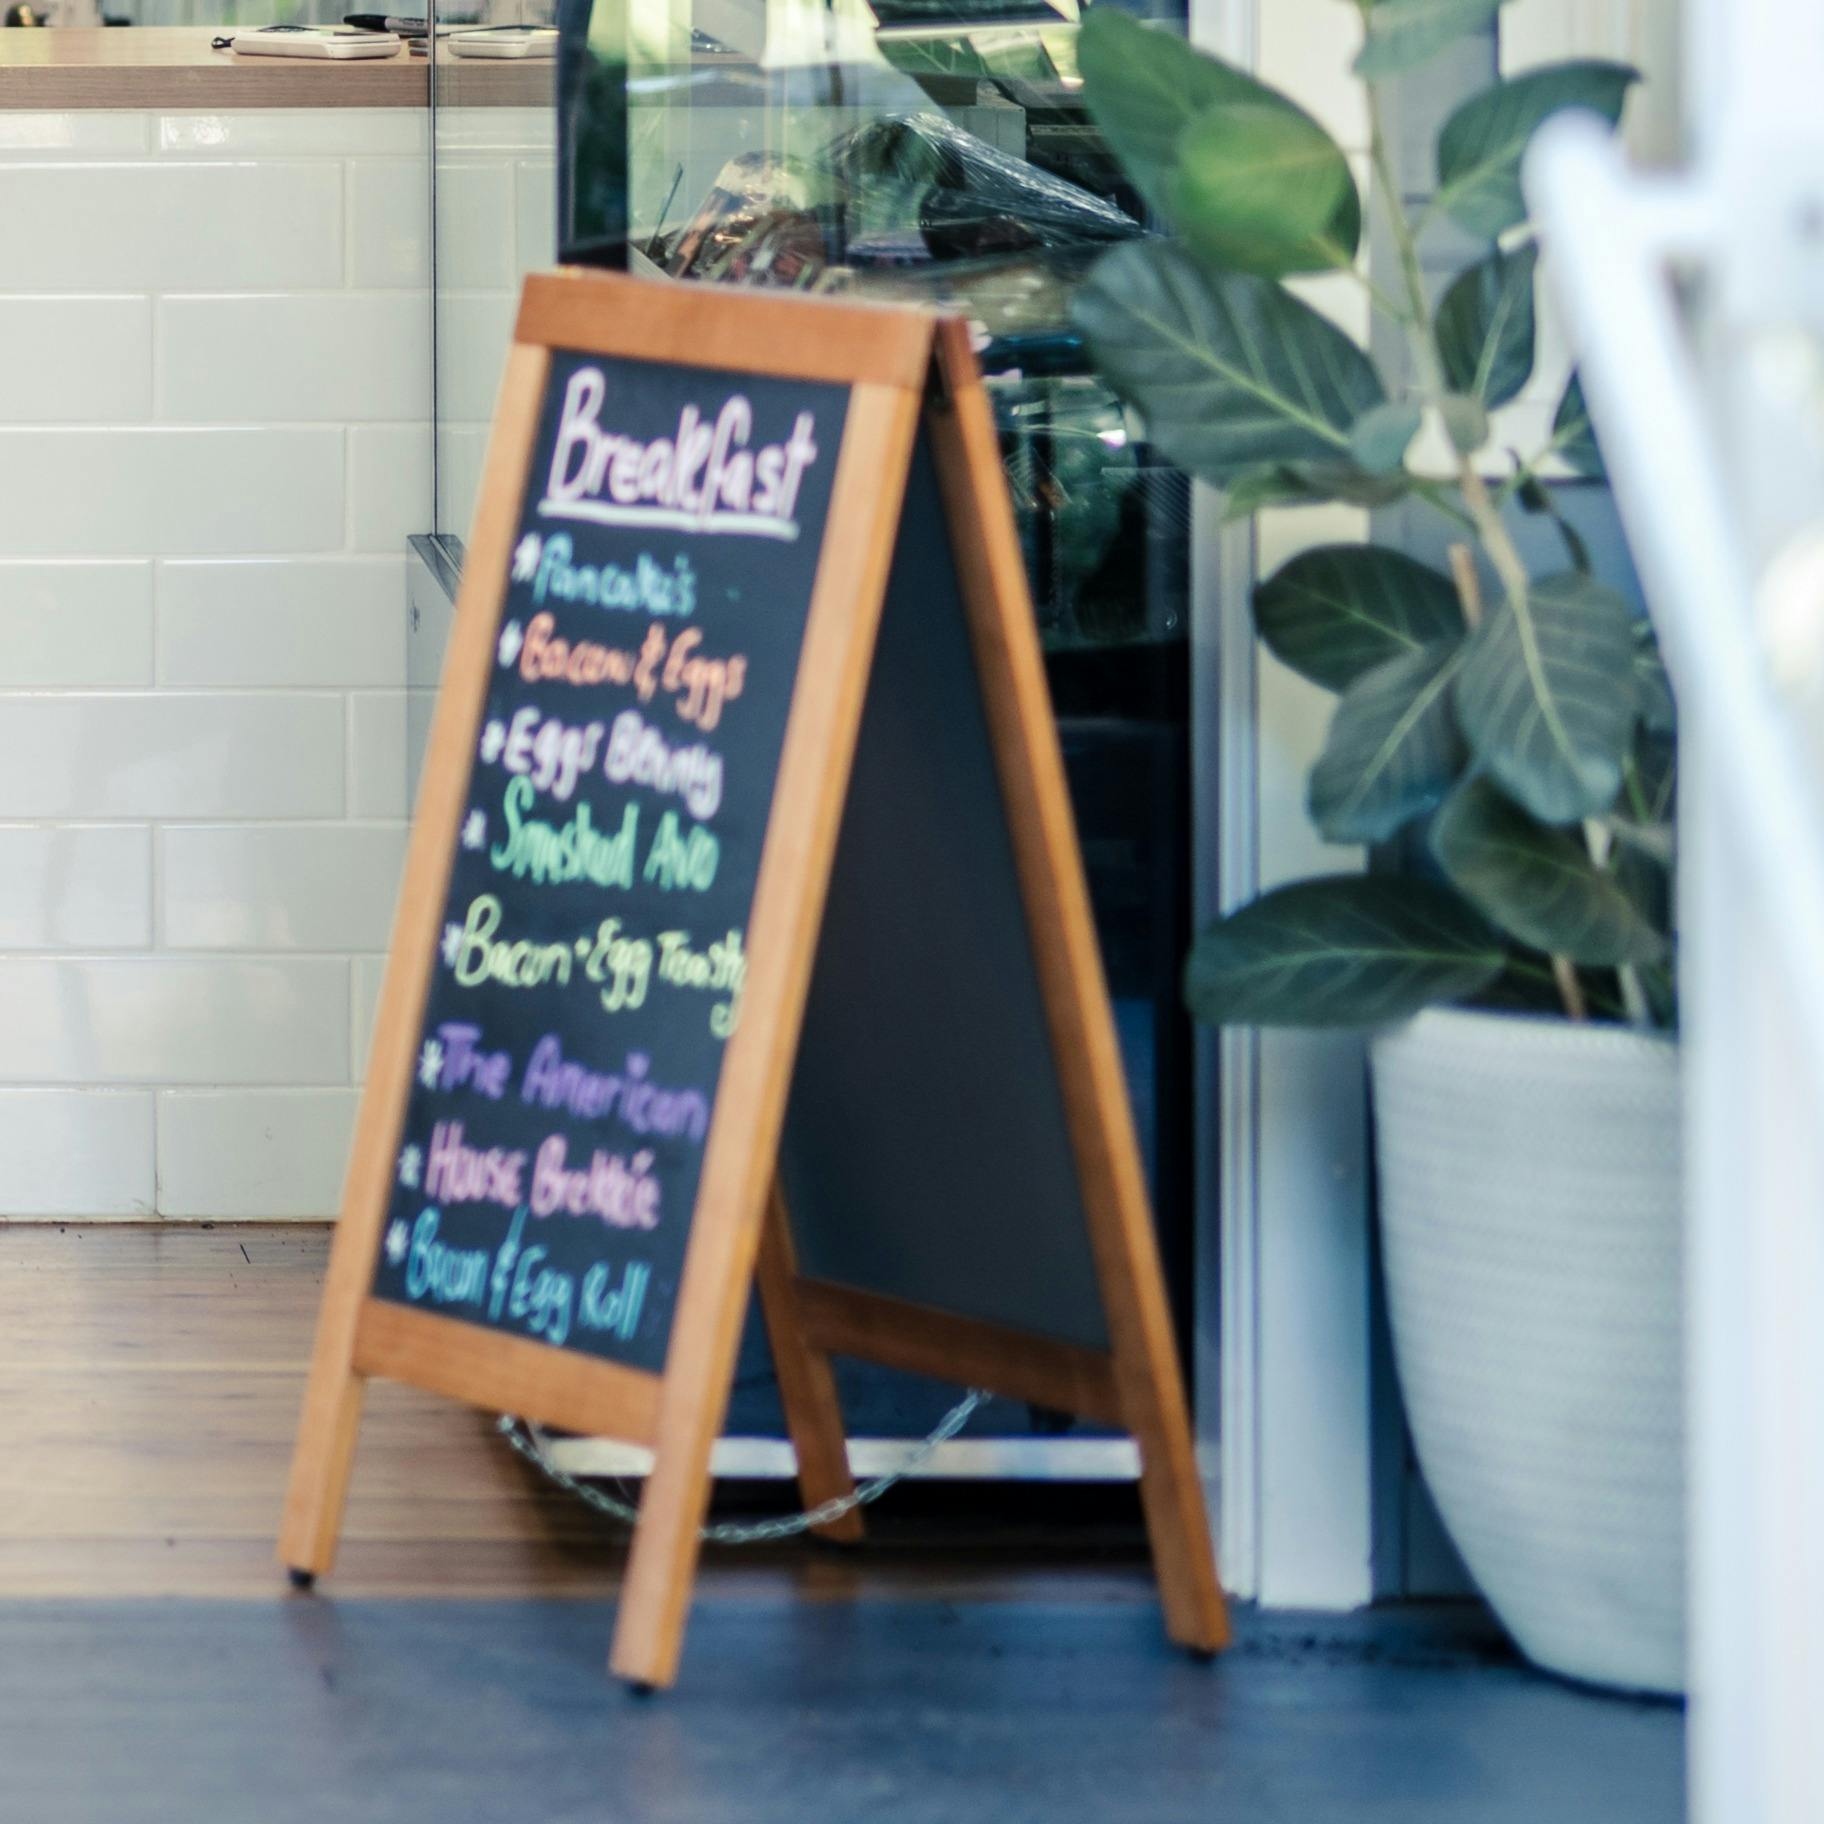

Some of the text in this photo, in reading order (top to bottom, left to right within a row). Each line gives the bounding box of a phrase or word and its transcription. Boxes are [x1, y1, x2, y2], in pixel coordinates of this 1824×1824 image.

[546, 364, 819, 530] Breakfast
[518, 610, 636, 685] Bacon
[662, 625, 749, 733] Eggs
[502, 705, 606, 801] Eggs
[453, 892, 573, 989] Bacon
[584, 916, 654, 1014] Egg
[435, 1020, 710, 1144] The American
[424, 1118, 529, 1209] House
[507, 1241, 575, 1347] Egg
[577, 1258, 653, 1342] Roll
